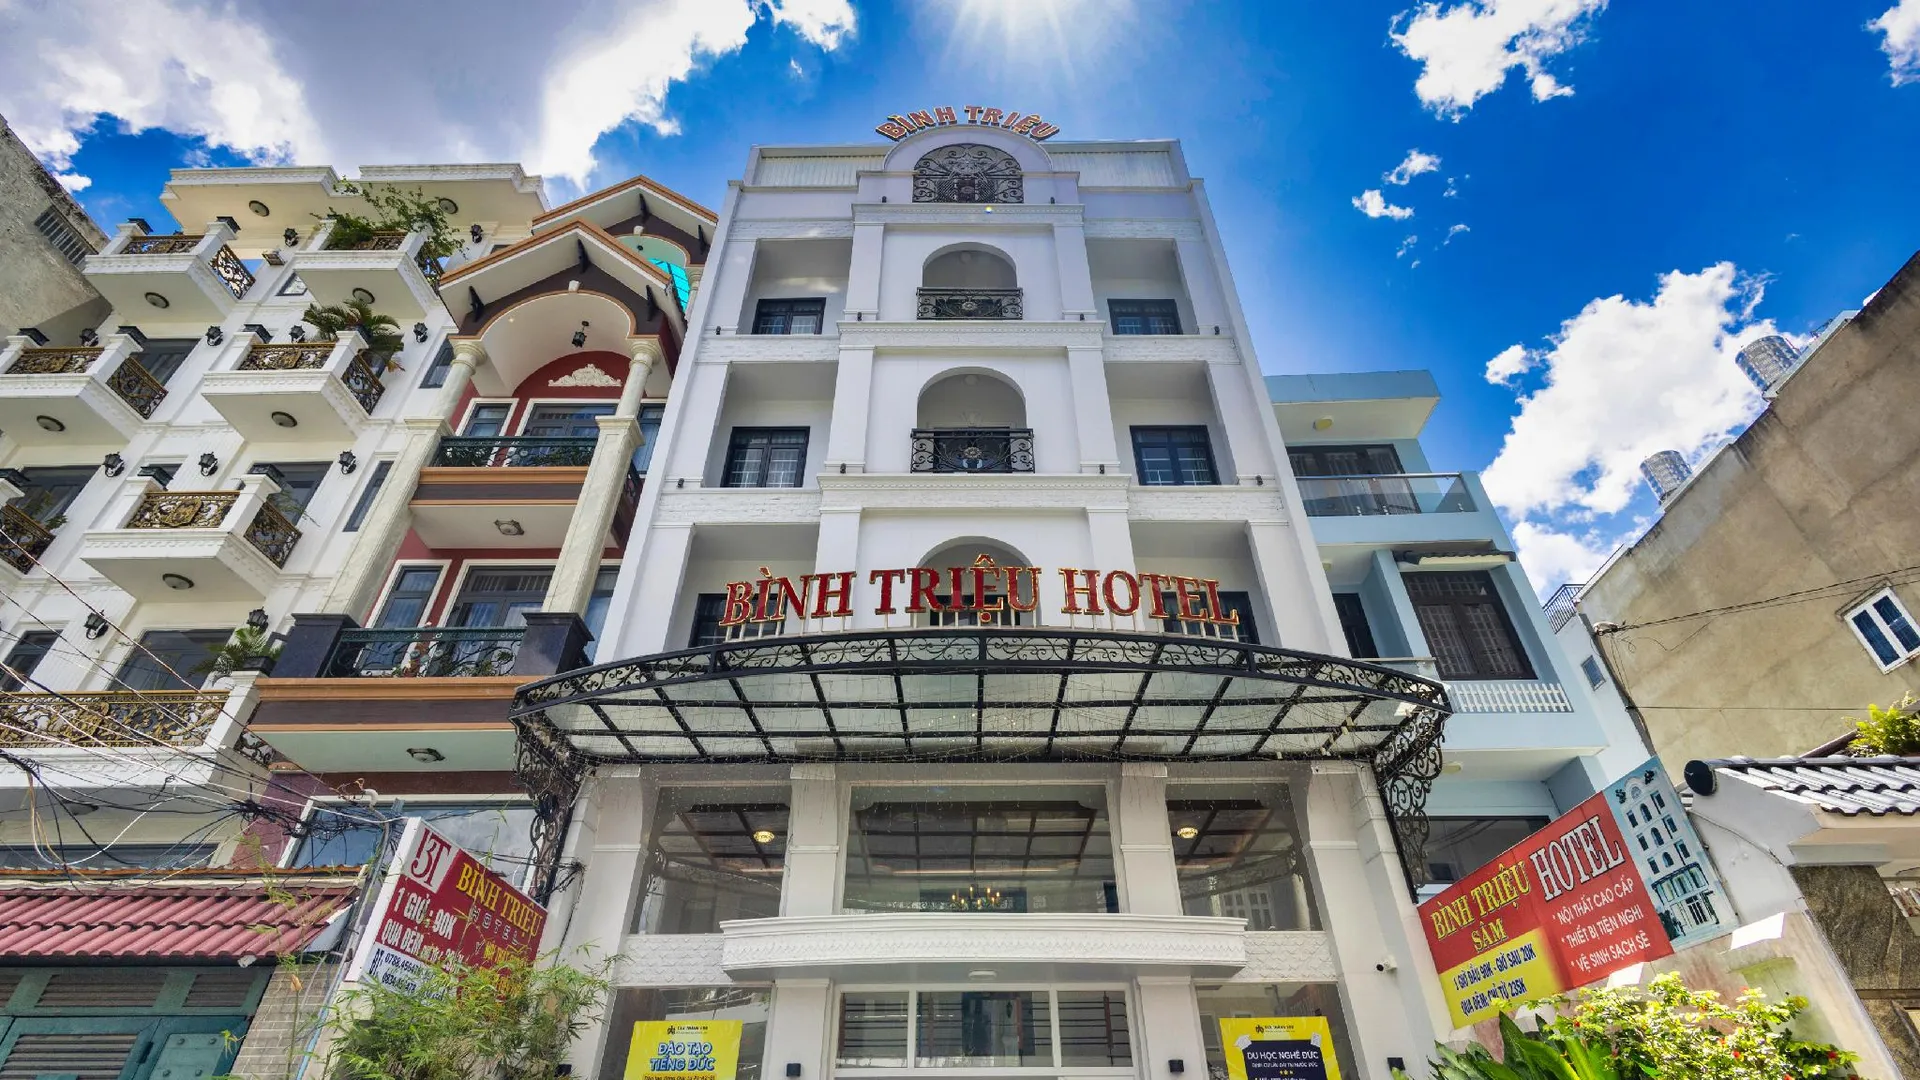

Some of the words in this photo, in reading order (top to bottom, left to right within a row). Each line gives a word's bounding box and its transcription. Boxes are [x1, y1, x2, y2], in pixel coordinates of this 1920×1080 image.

[875, 106, 957, 142] BÌNH
[964, 105, 1060, 141] TRIỆU
[719, 566, 856, 626] BÌNH
[870, 553, 1042, 623] TRIỆU
[1059, 567, 1239, 625] HOTEL
[1529, 814, 1626, 902] HOTEL
[394, 887, 406, 913] 1
[432, 908, 457, 940] 90K
[456, 862, 502, 912] BÌNH
[501, 892, 543, 938] TRIỆU
[1430, 901, 1475, 941] BÌNH
[1471, 860, 1531, 917] TRIỆU
[1557, 906, 1575, 925] NỘI
[1572, 894, 1594, 918] THẤT
[1593, 887, 1614, 908] CAO
[1614, 874, 1635, 899] CẤP
[381, 918, 403, 946] QUA
[401, 925, 425, 955] ĐÊM
[1471, 917, 1509, 954] SÂM
[1566, 924, 1590, 948] THIẾT
[1588, 925, 1600, 940] BỊ
[1597, 915, 1620, 936] TIỆN
[1617, 904, 1645, 927] NGHI
[1506, 949, 1522, 967] SAU
[1520, 943, 1537, 961] 20K
[1576, 952, 1591, 973] VỆ
[1590, 948, 1612, 968] SINH
[1609, 937, 1638, 961] SẠCH
[1508, 977, 1528, 997] 235K
[650, 1055, 686, 1071] TIẾNG
[687, 1055, 716, 1071] ĐỨC
[658, 1040, 686, 1056] ĐÀO
[687, 1041, 713, 1057] TẠO
[1247, 1051, 1259, 1059] DU
[1259, 1051, 1277, 1061] HỌC
[1301, 1050, 1319, 1059] ĐỨC
